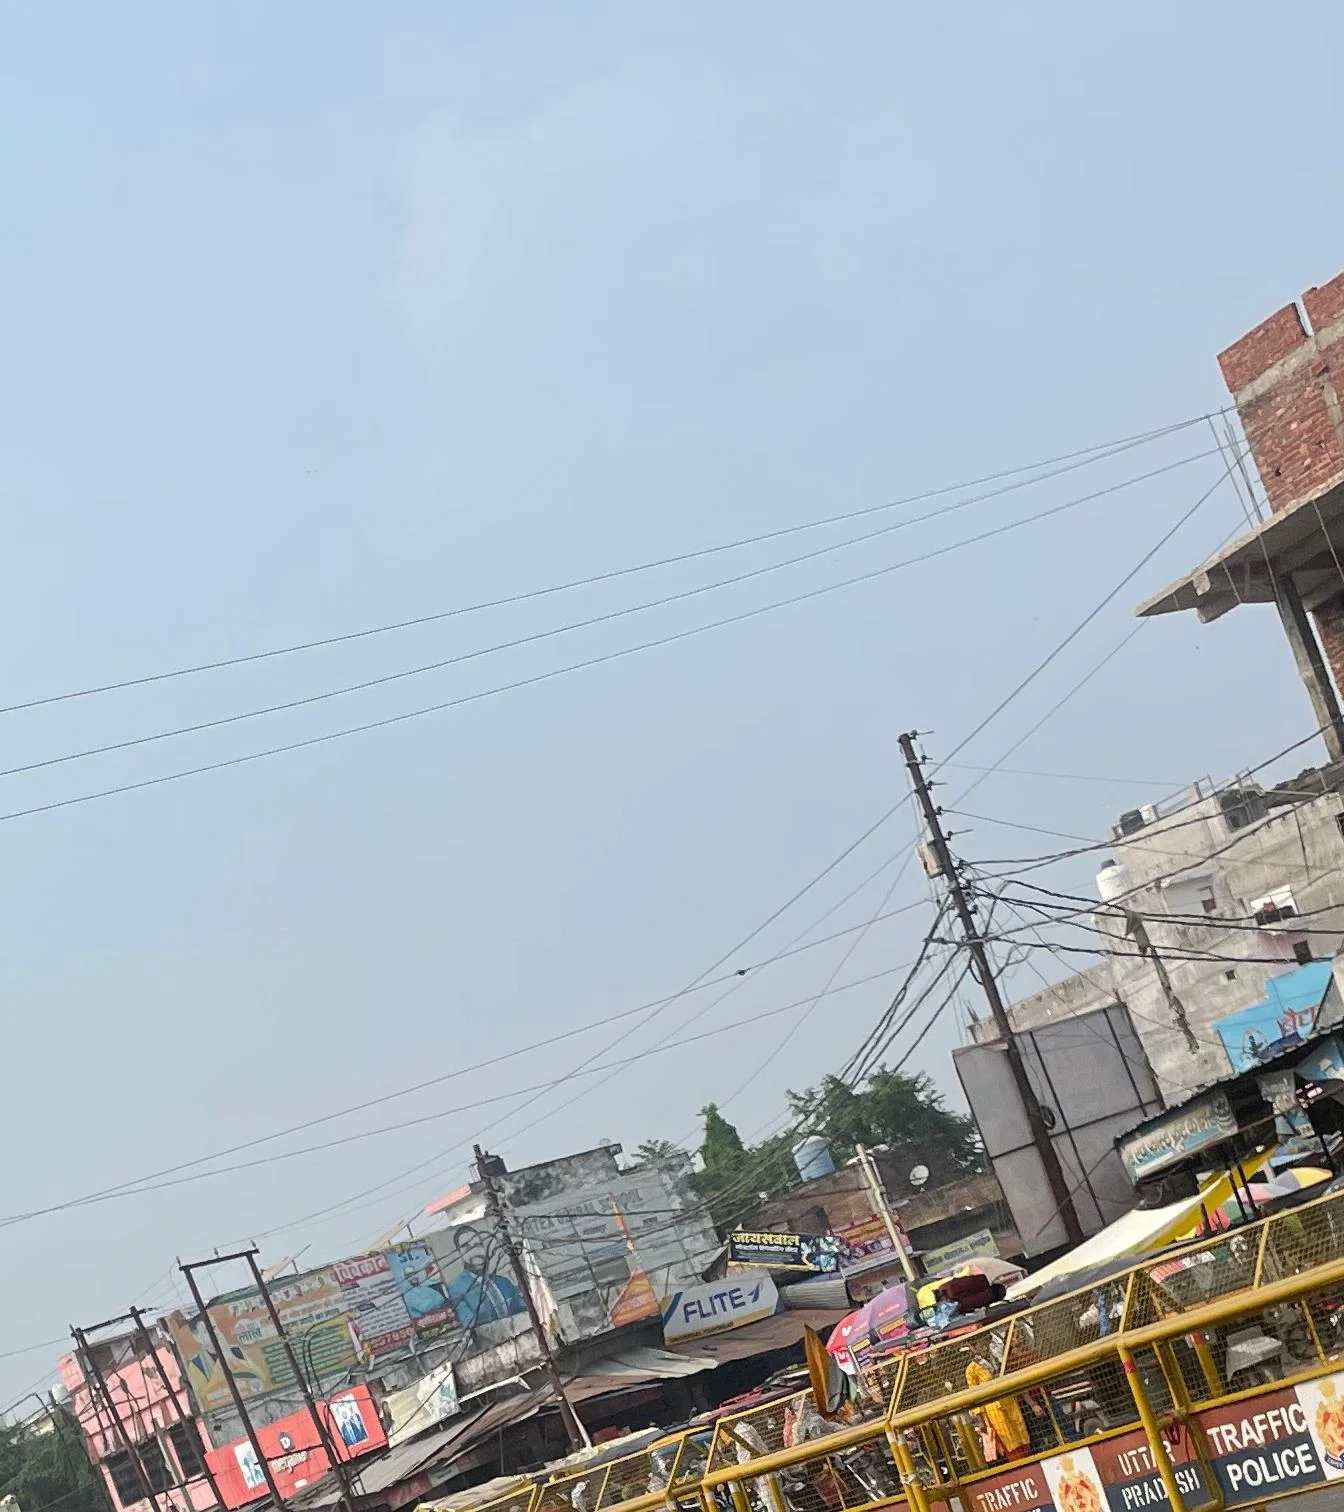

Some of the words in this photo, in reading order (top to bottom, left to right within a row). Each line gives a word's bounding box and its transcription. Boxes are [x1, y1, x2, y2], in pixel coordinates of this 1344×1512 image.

[683, 1287, 746, 1324] FLITE
[1207, 1402, 1308, 1455] TRAFFIC
[1122, 1467, 1200, 1510] PRADSH
[1226, 1443, 1317, 1492] POLICE
